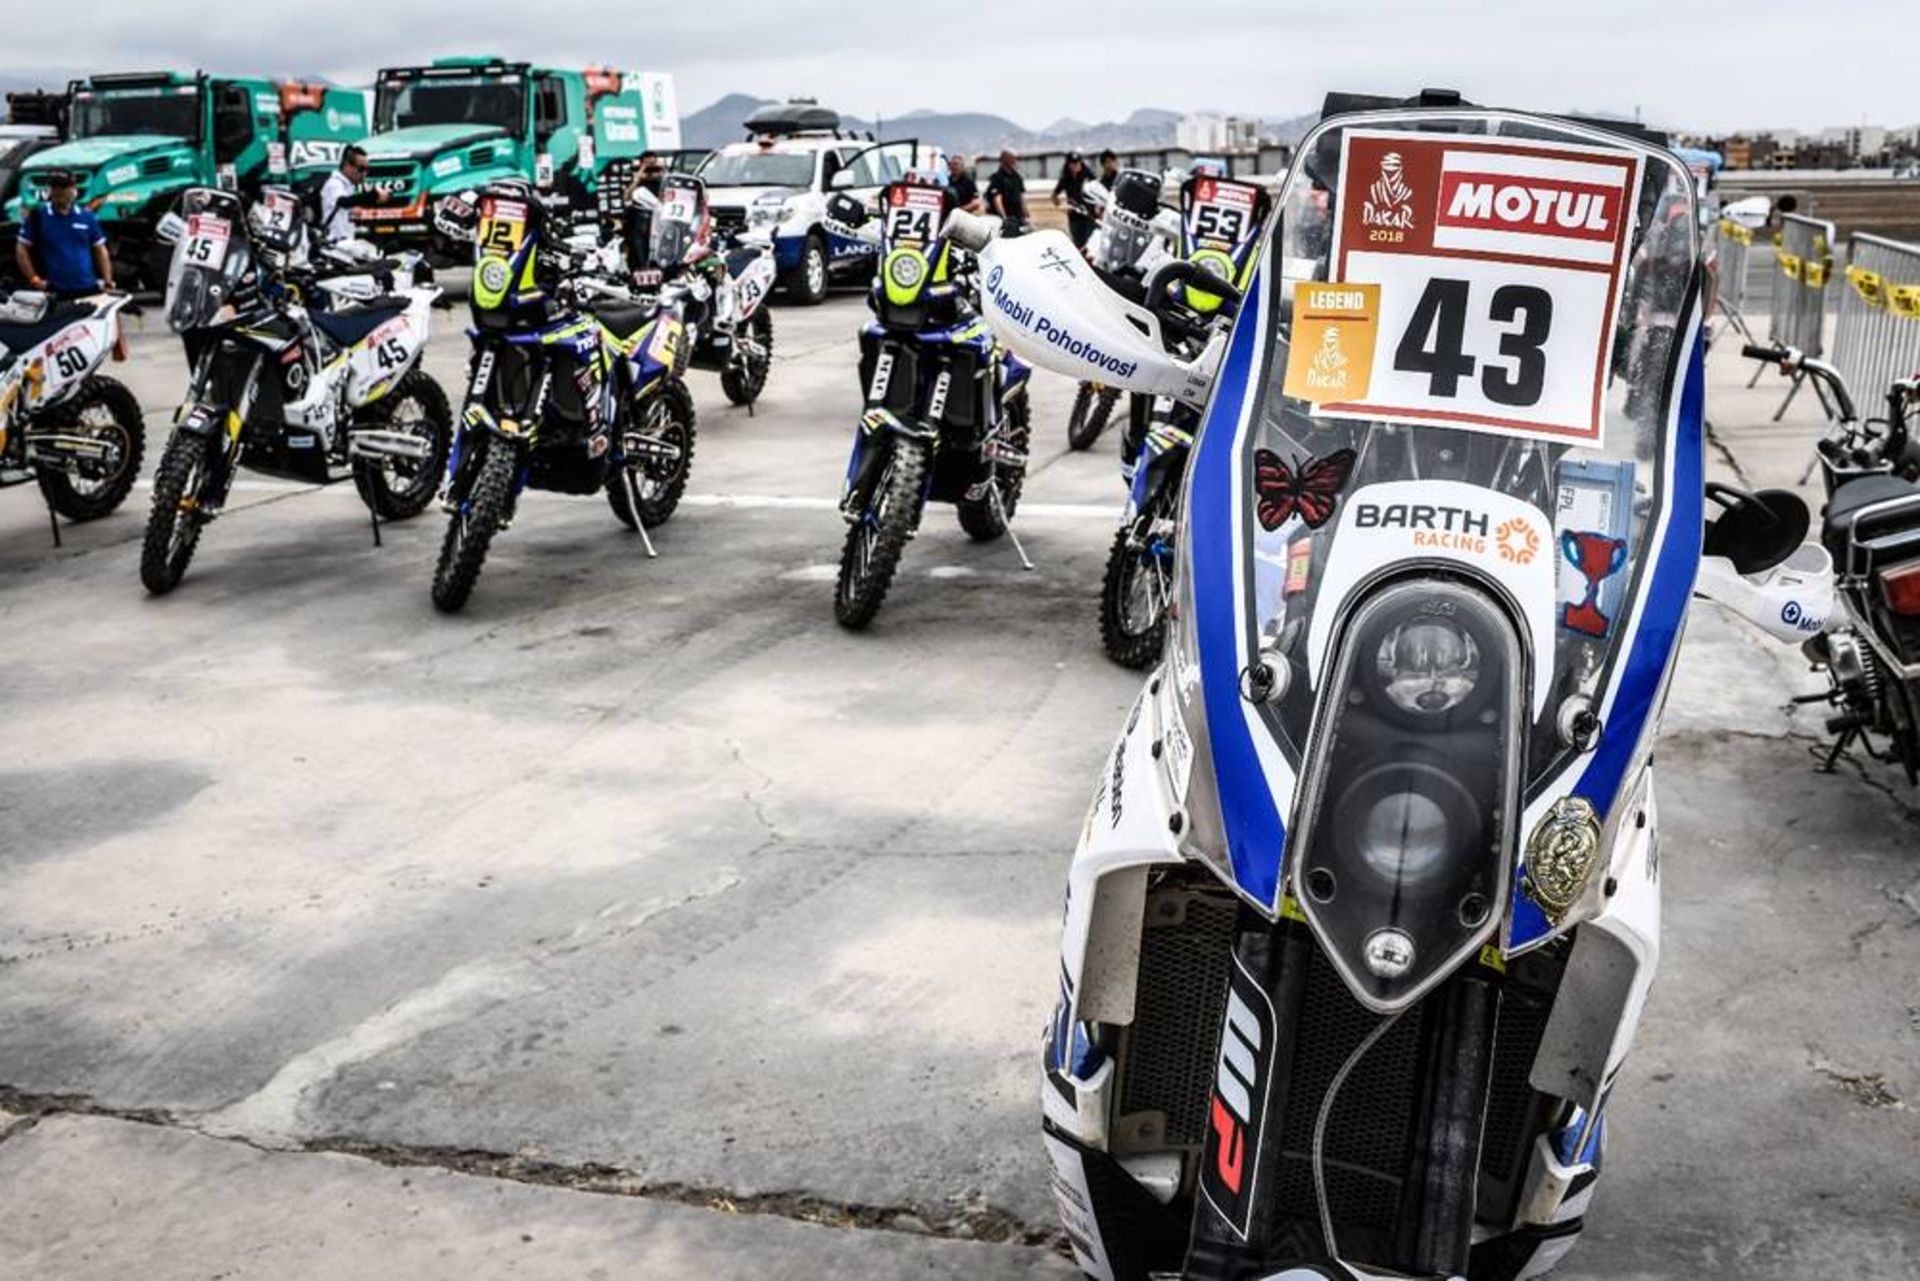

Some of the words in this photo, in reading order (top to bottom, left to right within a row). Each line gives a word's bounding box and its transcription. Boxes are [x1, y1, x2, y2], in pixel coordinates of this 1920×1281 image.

[1448, 182, 1611, 233] MOTUL
[481, 221, 514, 252] 12
[892, 211, 931, 243] 24
[1196, 205, 1243, 244] 53
[1367, 229, 1405, 243] 2018
[186, 236, 213, 262] 45
[1309, 290, 1365, 310] LEGEND
[994, 288, 1035, 328] Mobil
[1034, 316, 1137, 379] Pohotovost
[1393, 276, 1554, 408] 43
[55, 345, 89, 378] 50
[375, 336, 409, 371] 45
[1559, 486, 1575, 514] FPL
[1355, 504, 1489, 537] BARTH
[1414, 531, 1486, 555] RACING
